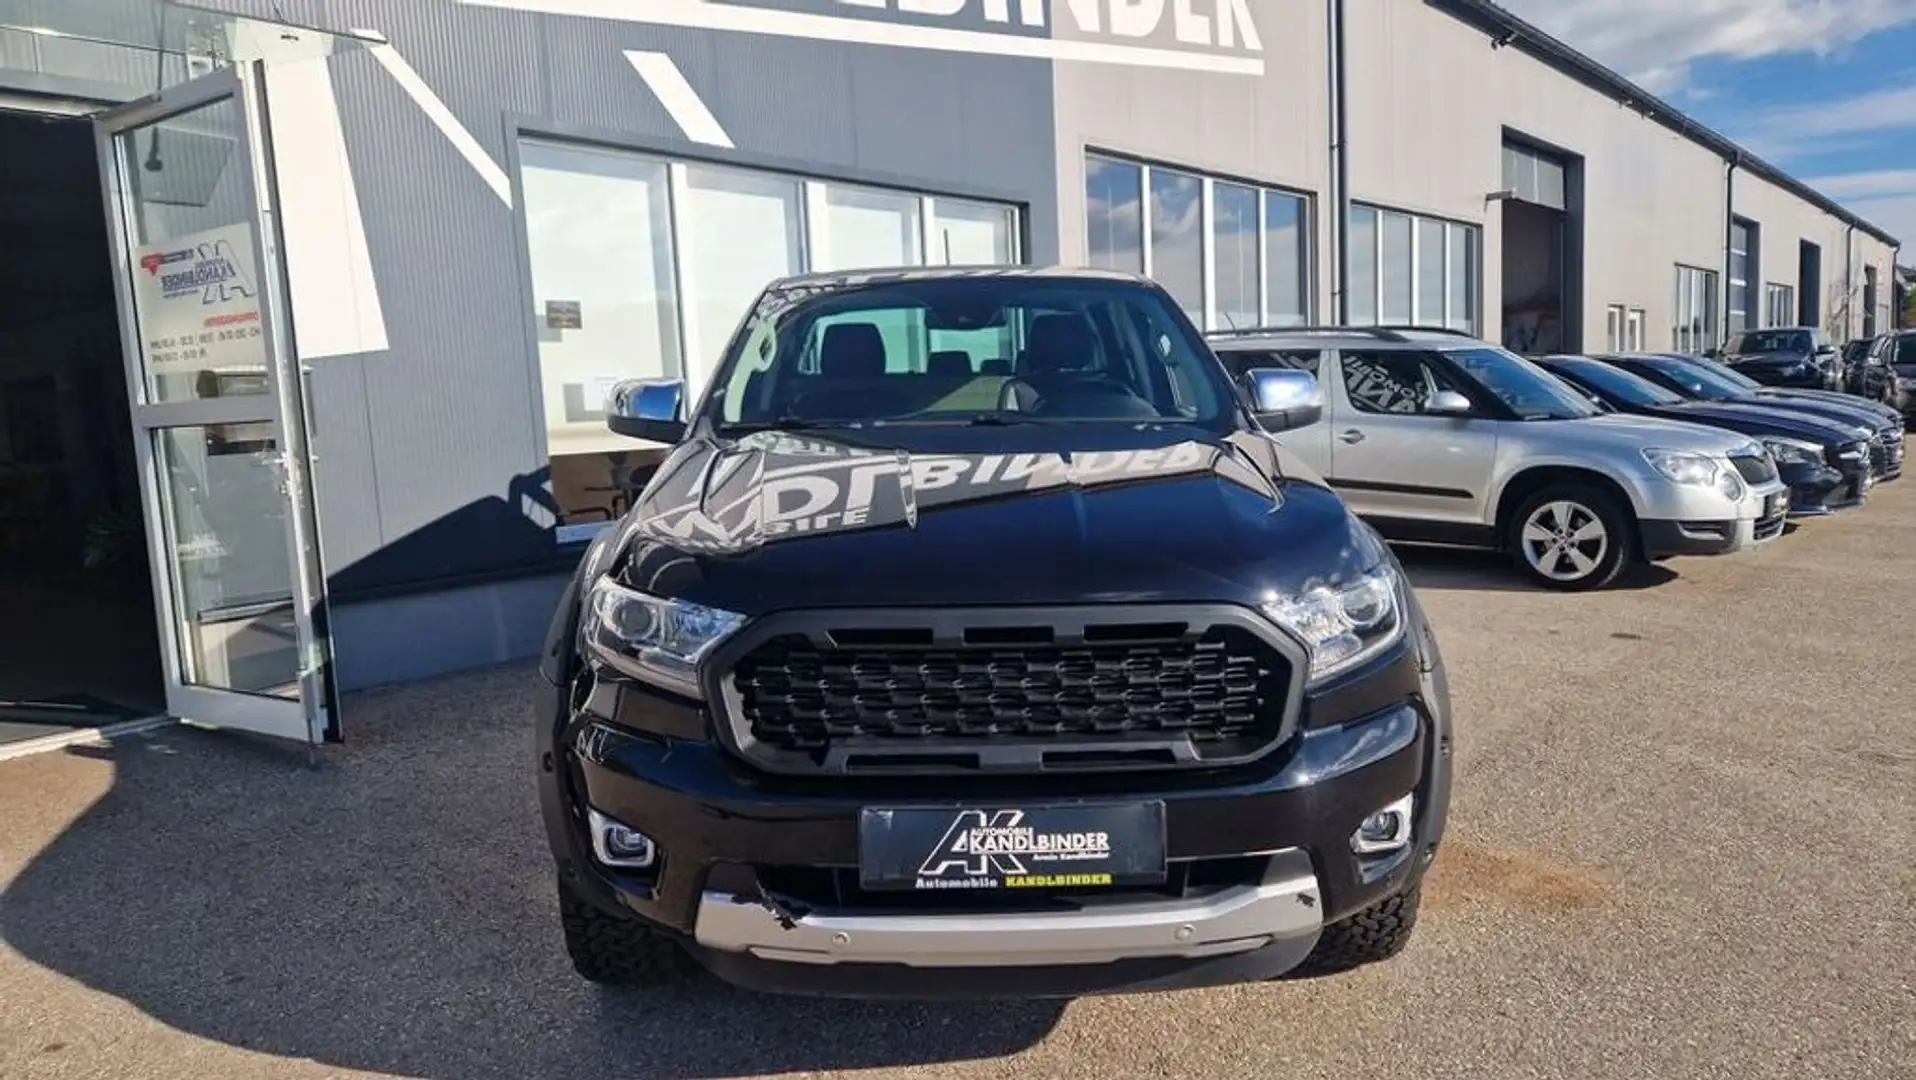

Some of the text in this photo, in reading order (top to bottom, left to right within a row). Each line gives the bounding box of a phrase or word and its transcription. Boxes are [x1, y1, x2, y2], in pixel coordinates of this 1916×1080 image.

[970, 827, 1110, 851] KANDLBINDER
[915, 874, 1112, 888] Automobile KANDLBINDER
